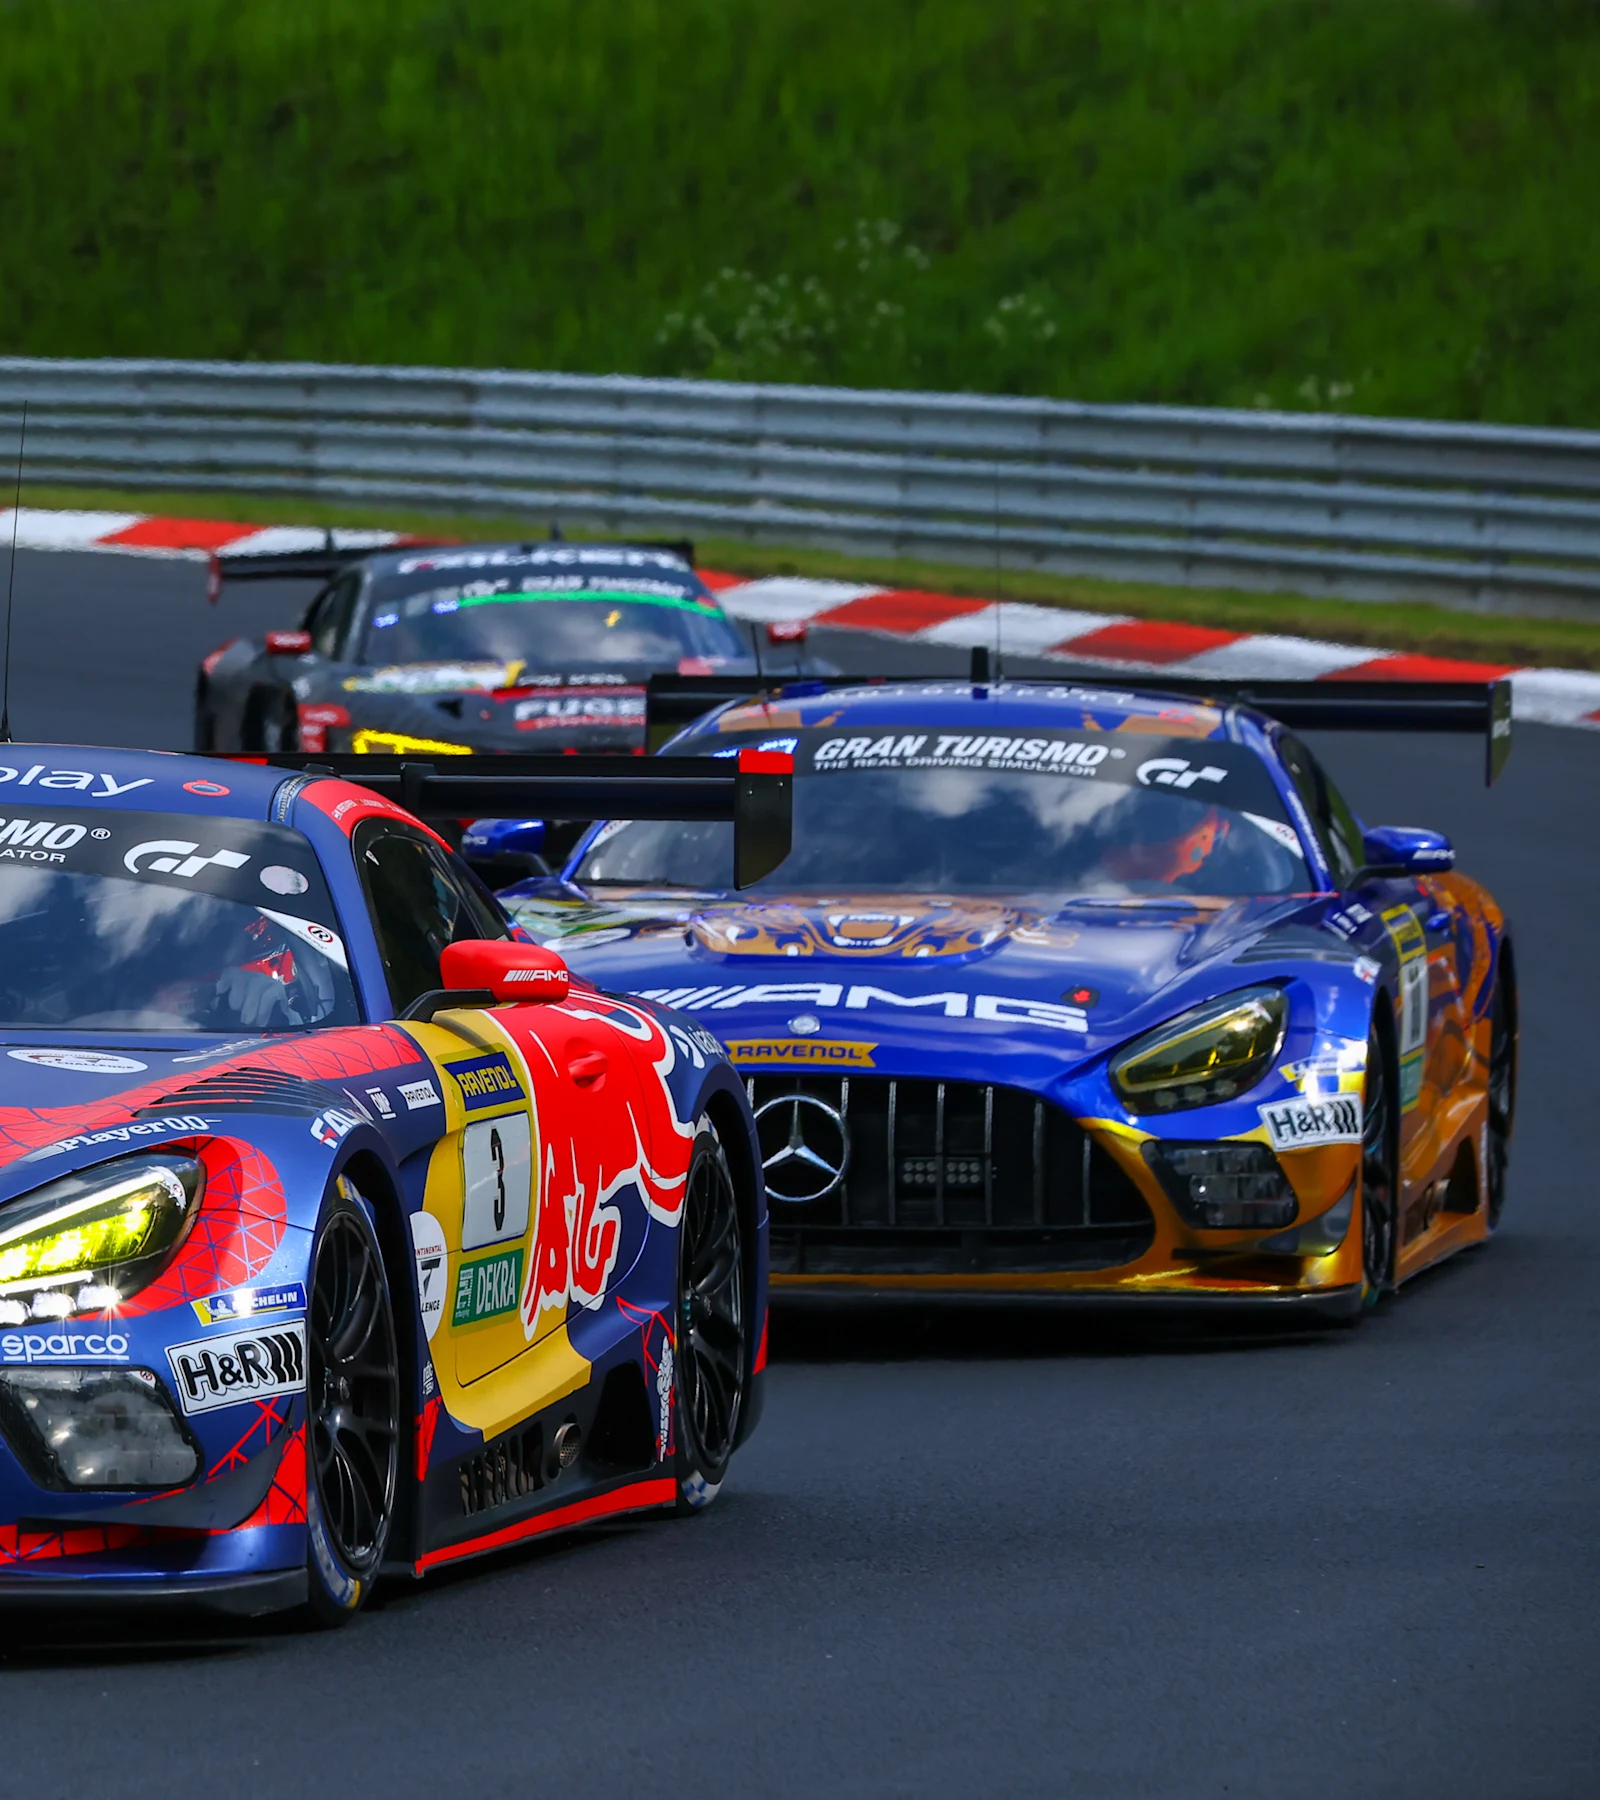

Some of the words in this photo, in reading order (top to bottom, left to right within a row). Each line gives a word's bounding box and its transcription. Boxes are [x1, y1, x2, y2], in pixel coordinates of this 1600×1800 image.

[814, 735, 928, 760] GRAN
[932, 735, 1111, 766] TURISMO
[814, 761, 850, 771] THE
[853, 757, 901, 769] REAL
[906, 755, 983, 767] DRIVING
[987, 758, 1097, 777] SIMULATOR
[718, 983, 1089, 1034] AMG
[736, 1044, 864, 1060] RAVENOL
[456, 1065, 518, 1098] RAVENOL
[1268, 1103, 1332, 1139] H&R
[491, 1128, 506, 1232] 3
[476, 1256, 516, 1315] DEKRA
[2, 1334, 129, 1362] sparco
[179, 1343, 269, 1396] H&R
